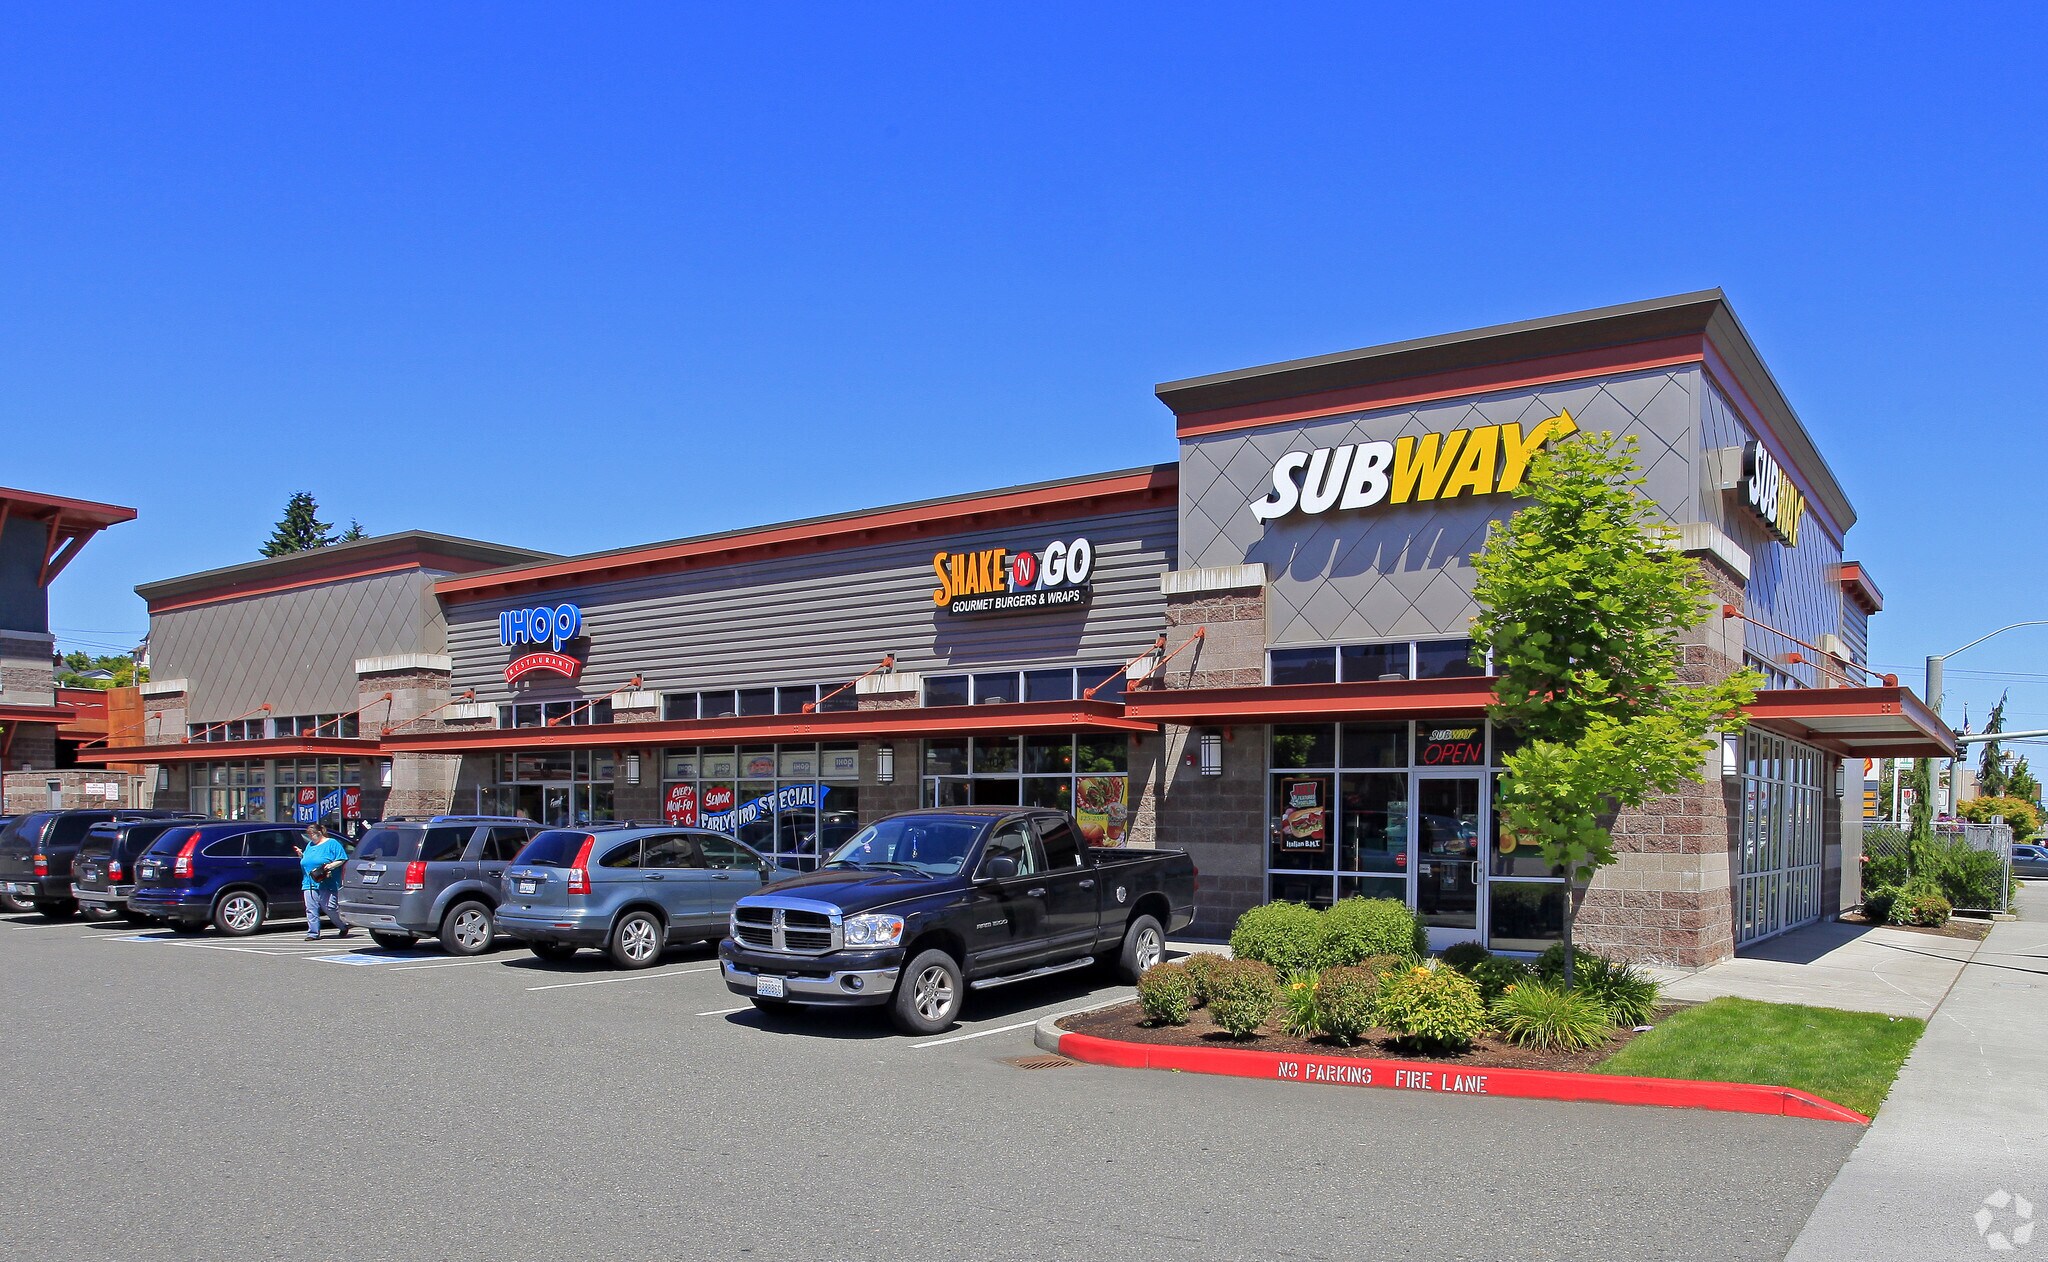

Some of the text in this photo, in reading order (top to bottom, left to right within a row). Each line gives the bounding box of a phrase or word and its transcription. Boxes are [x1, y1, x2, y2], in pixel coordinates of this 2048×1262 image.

[1249, 407, 1579, 524] SUBWAY
[1748, 440, 1805, 548] SUBWAY
[933, 548, 1006, 607] SHAKE
[1042, 538, 1091, 586] GO
[952, 589, 1080, 613] GOURMET BURGERS & WRAPS
[509, 657, 570, 676] RESTAURANT
[1429, 728, 1477, 741] SUBWAY
[1423, 743, 1482, 764] OPEN
[301, 789, 315, 802] KIDS
[672, 786, 693, 798] EVERY
[706, 791, 730, 806] SENIOR
[758, 787, 815, 812] SPECIAL
[300, 807, 314, 820] EAT
[320, 794, 338, 815] FREE
[667, 799, 693, 812] MON-FRI
[1278, 1061, 1488, 1093] NO PARKING FIRE LANE
